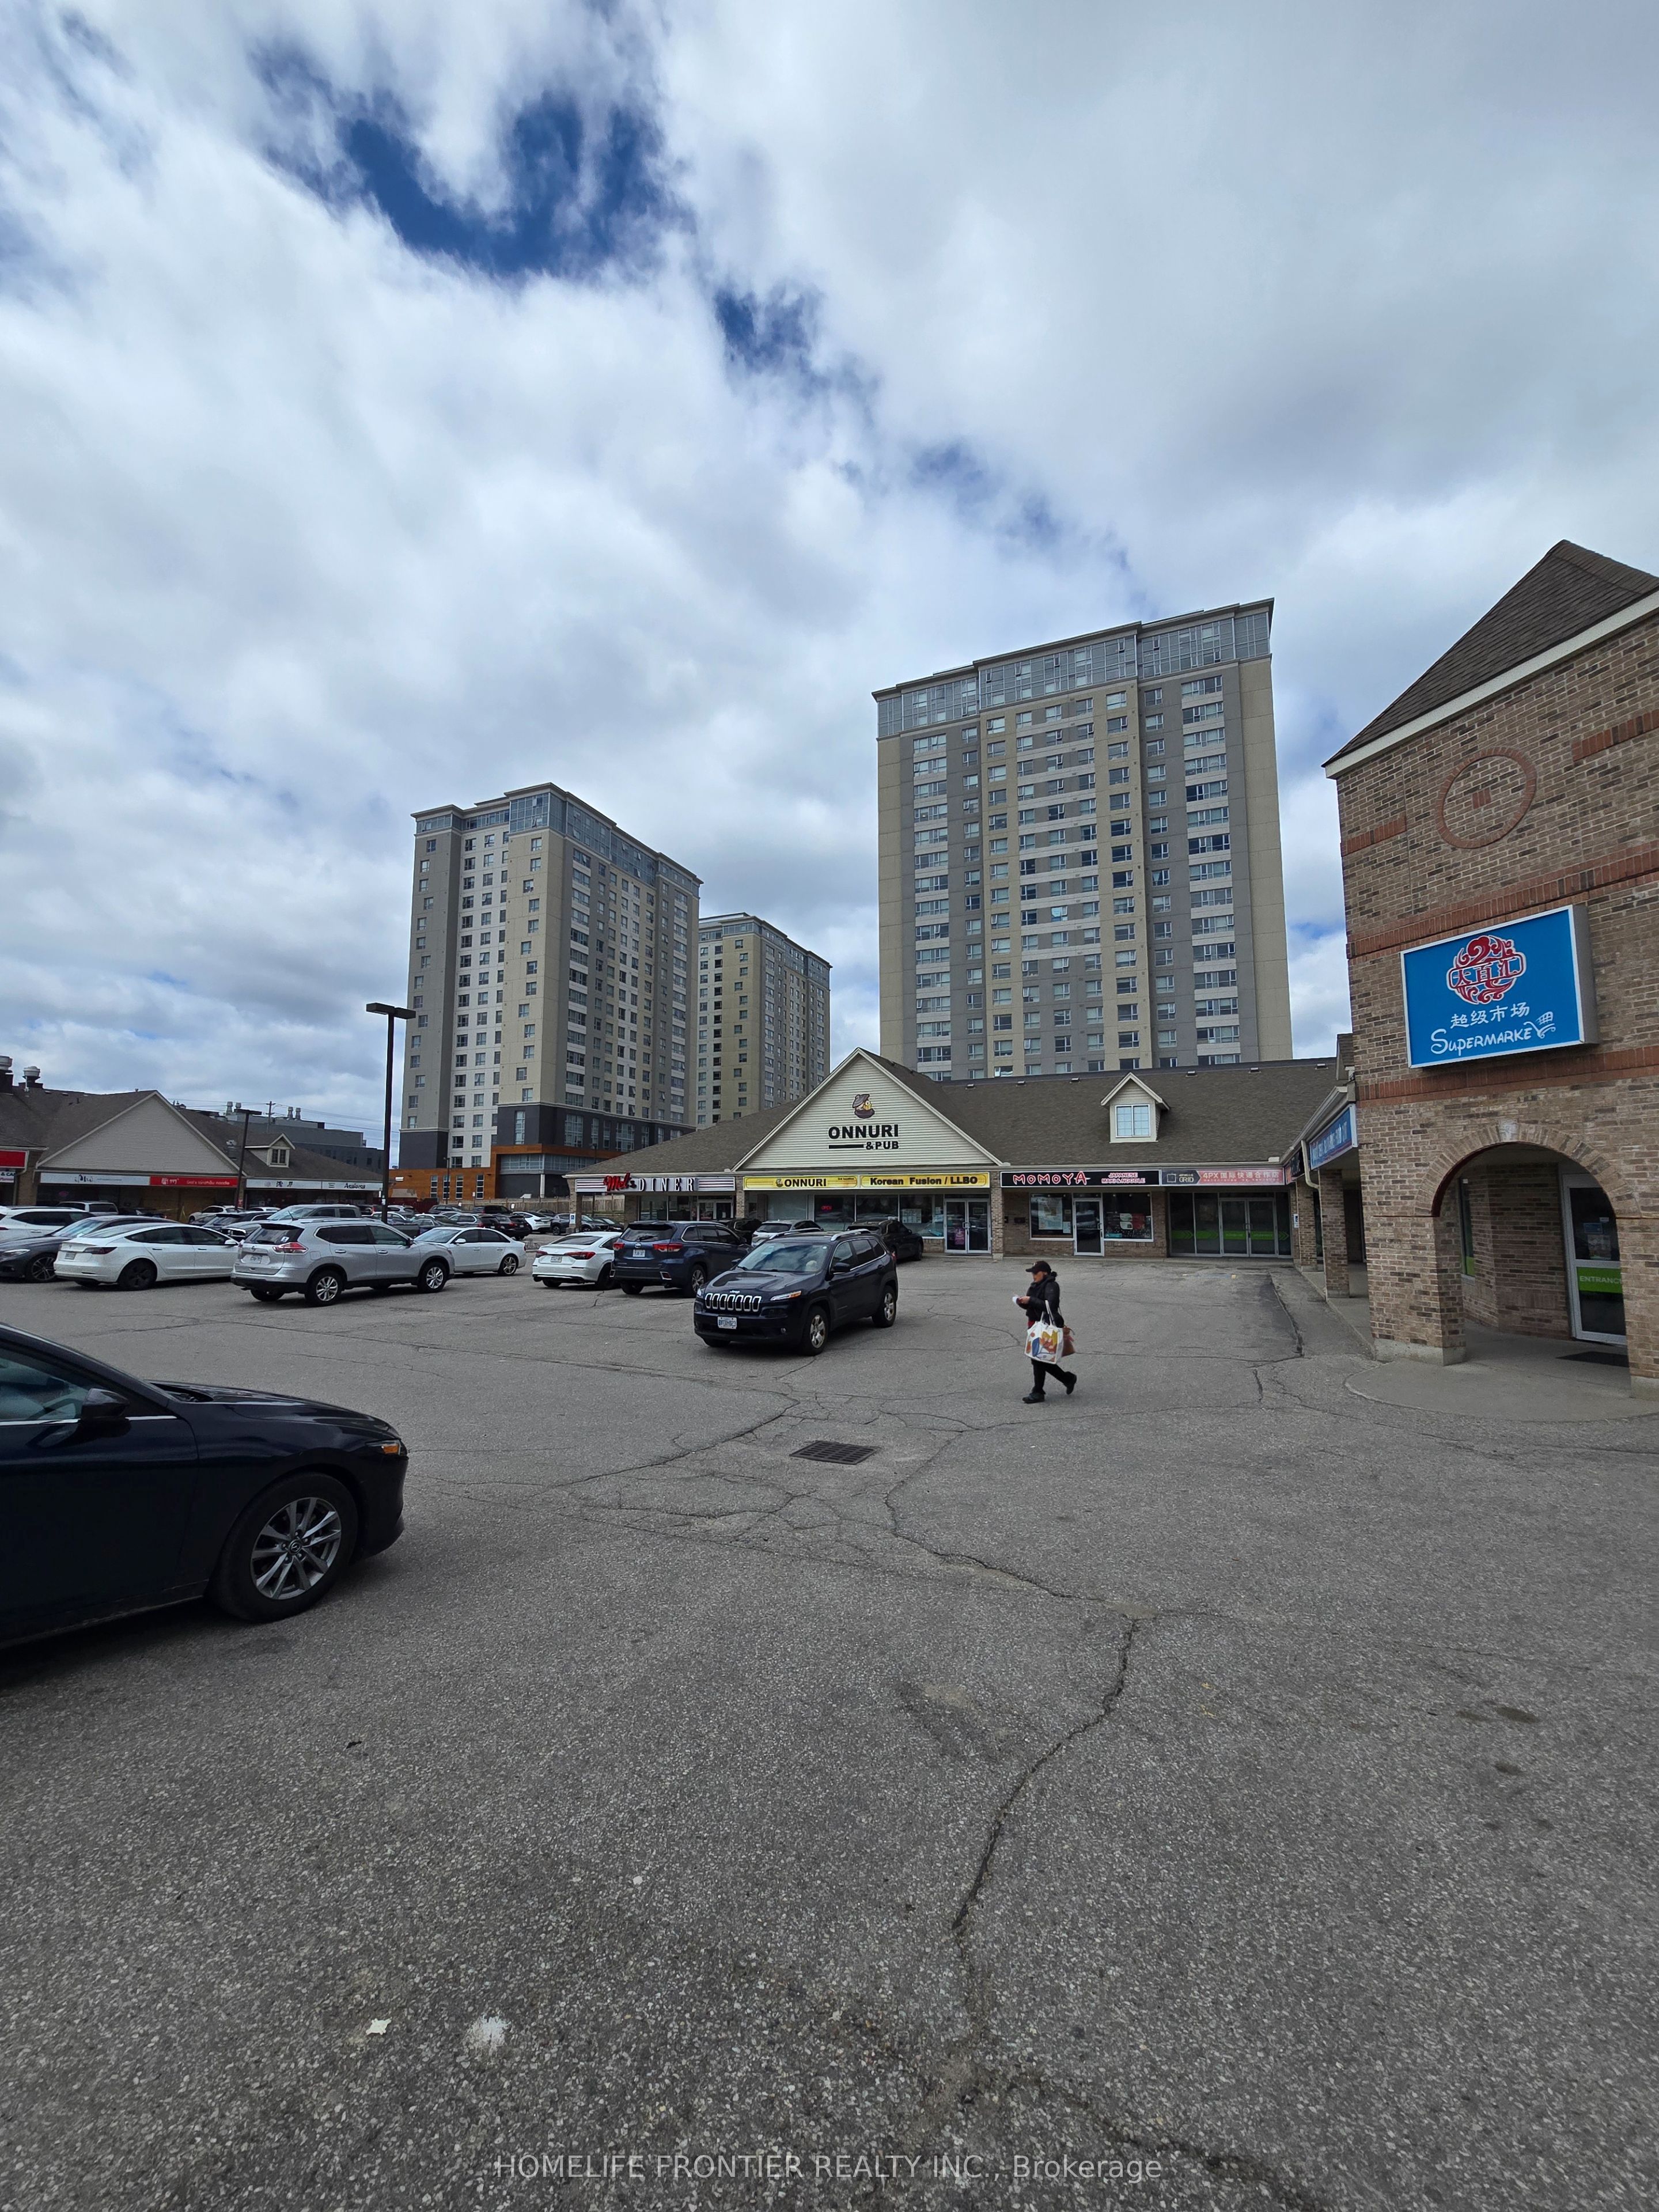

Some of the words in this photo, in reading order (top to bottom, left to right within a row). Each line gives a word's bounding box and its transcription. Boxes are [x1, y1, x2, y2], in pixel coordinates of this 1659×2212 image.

[1452, 957, 1521, 986] 大百汇
[1450, 1001, 1530, 1029] 超级市场
[828, 1124, 899, 1139] ONNURI
[875, 1141, 899, 1150] PUB
[638, 1177, 694, 1192] DINER
[784, 1179, 827, 1187] ONNURI
[870, 1177, 904, 1185] Korean
[909, 1177, 942, 1185] Fusion
[950, 1176, 978, 1184] LLBO
[1013, 1171, 1091, 1185] MOMOYA
